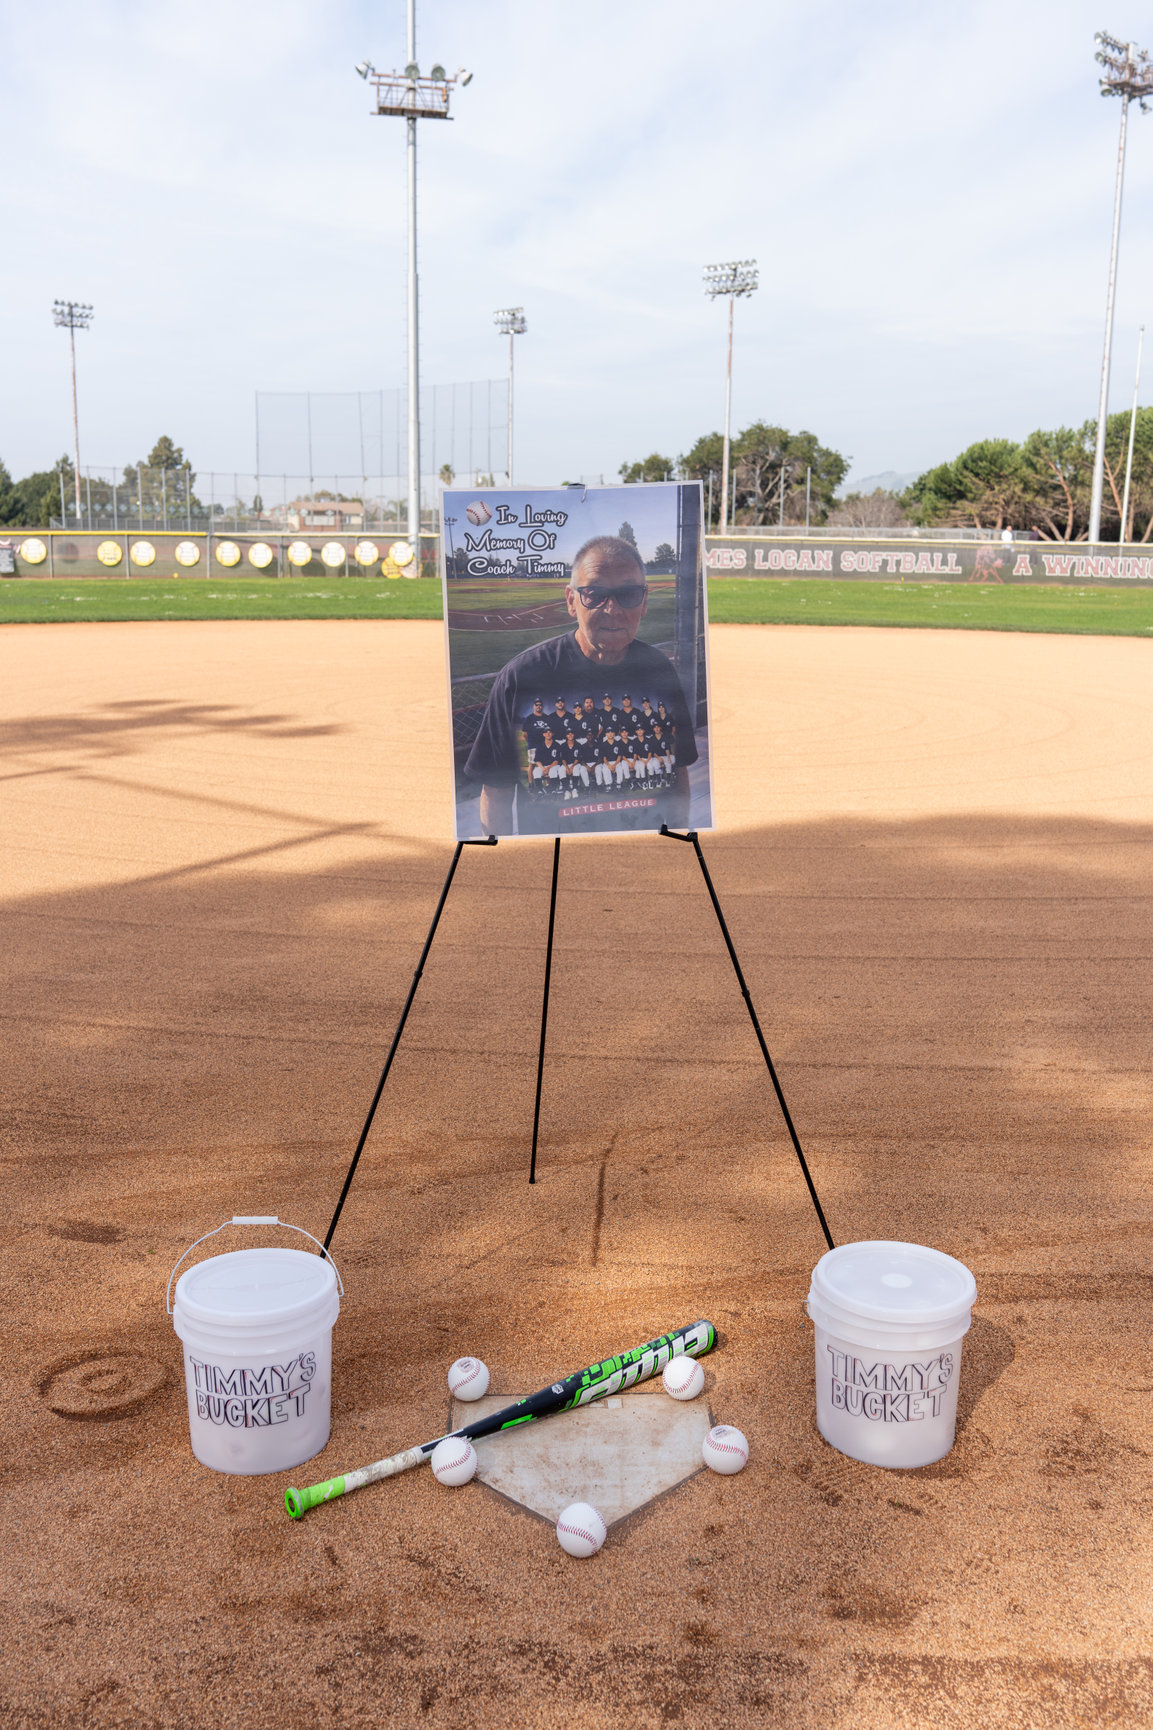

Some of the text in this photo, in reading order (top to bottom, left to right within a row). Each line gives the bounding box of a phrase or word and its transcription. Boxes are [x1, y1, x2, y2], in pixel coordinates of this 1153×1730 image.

[495, 504, 568, 528] In Loving
[464, 528, 557, 554] Memory Of
[466, 554, 565, 576] Coach Timmy
[755, 549, 833, 571] LOGAN
[840, 551, 962, 574] SOFTBALL
[1012, 554, 1032, 576] A
[562, 798, 654, 817] LITTLE LEAGUE
[189, 1351, 317, 1396] TIMMY'S
[827, 1344, 954, 1391] TIMMY'S
[195, 1382, 311, 1428] BUCKET
[832, 1377, 947, 1423] BUCKET
